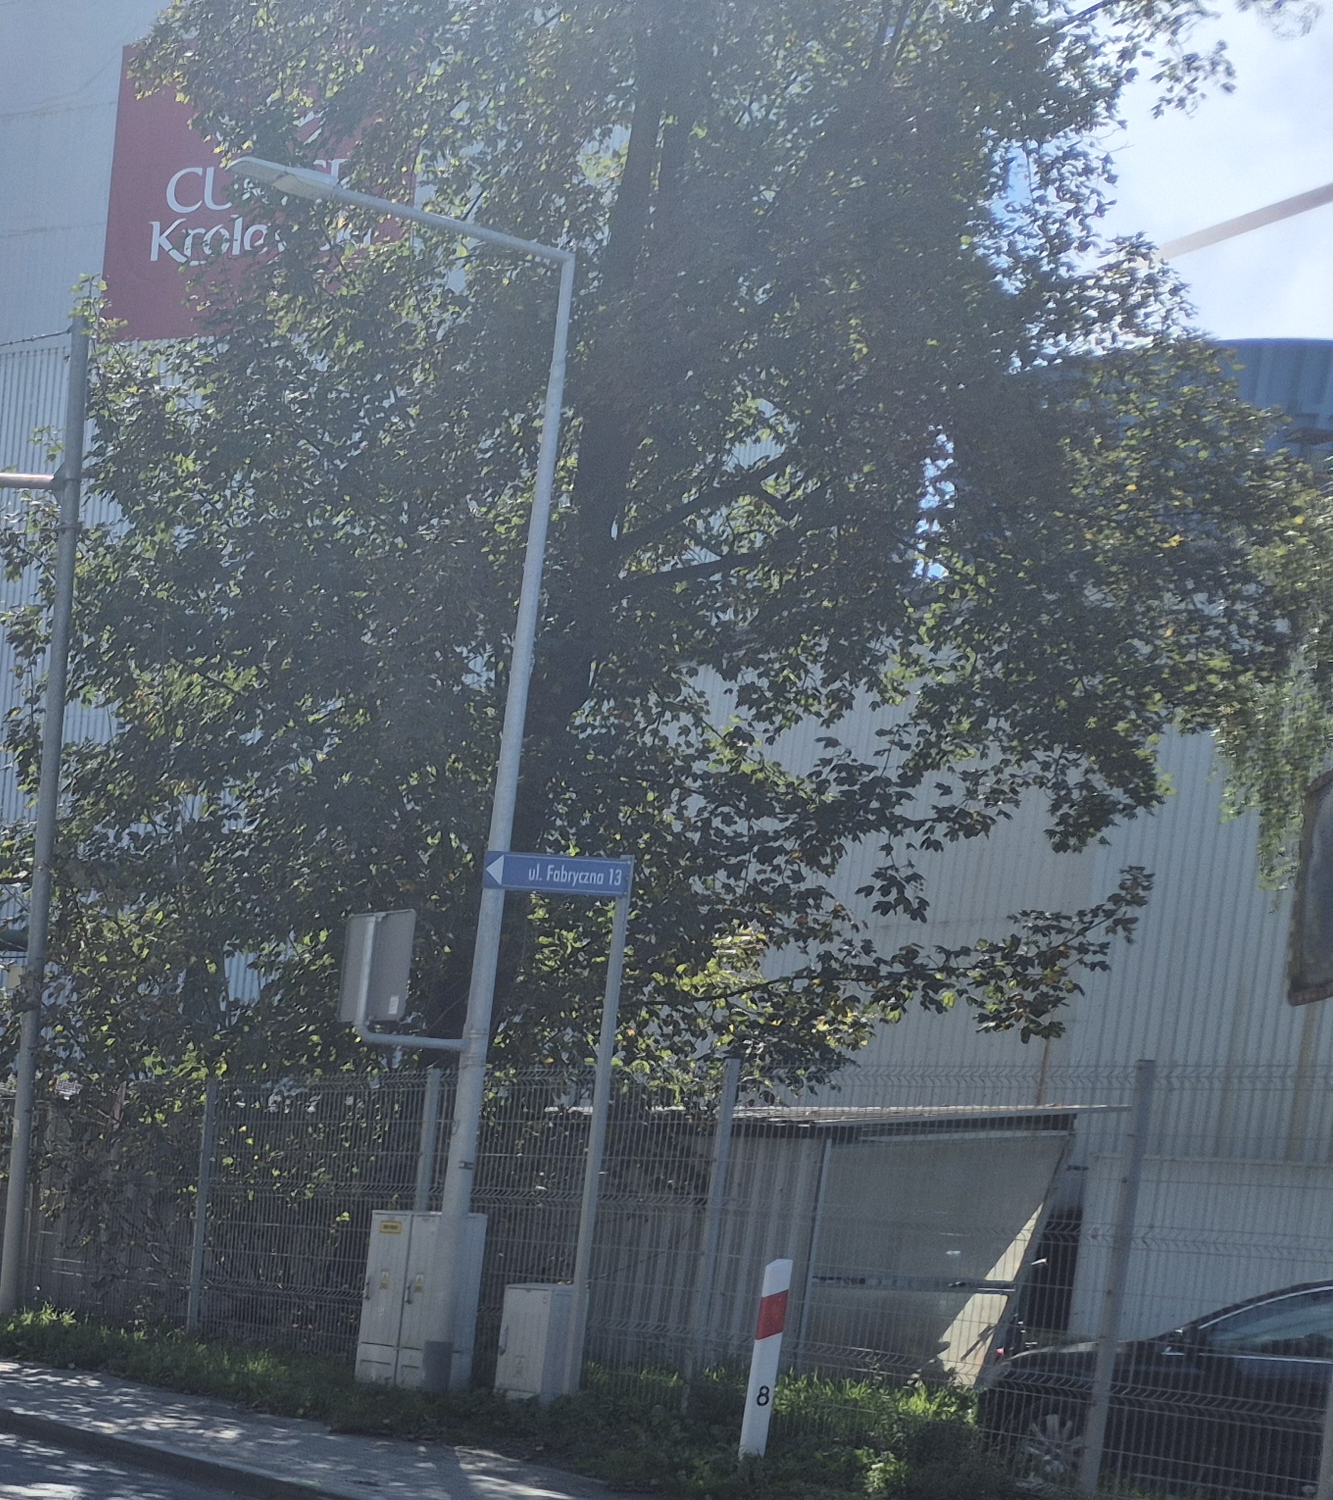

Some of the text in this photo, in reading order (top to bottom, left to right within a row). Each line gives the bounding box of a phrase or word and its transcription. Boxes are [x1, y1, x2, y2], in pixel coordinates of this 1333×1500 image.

[528, 862, 623, 887] ul. Fabryczna 13
[756, 1384, 770, 1407] 8
